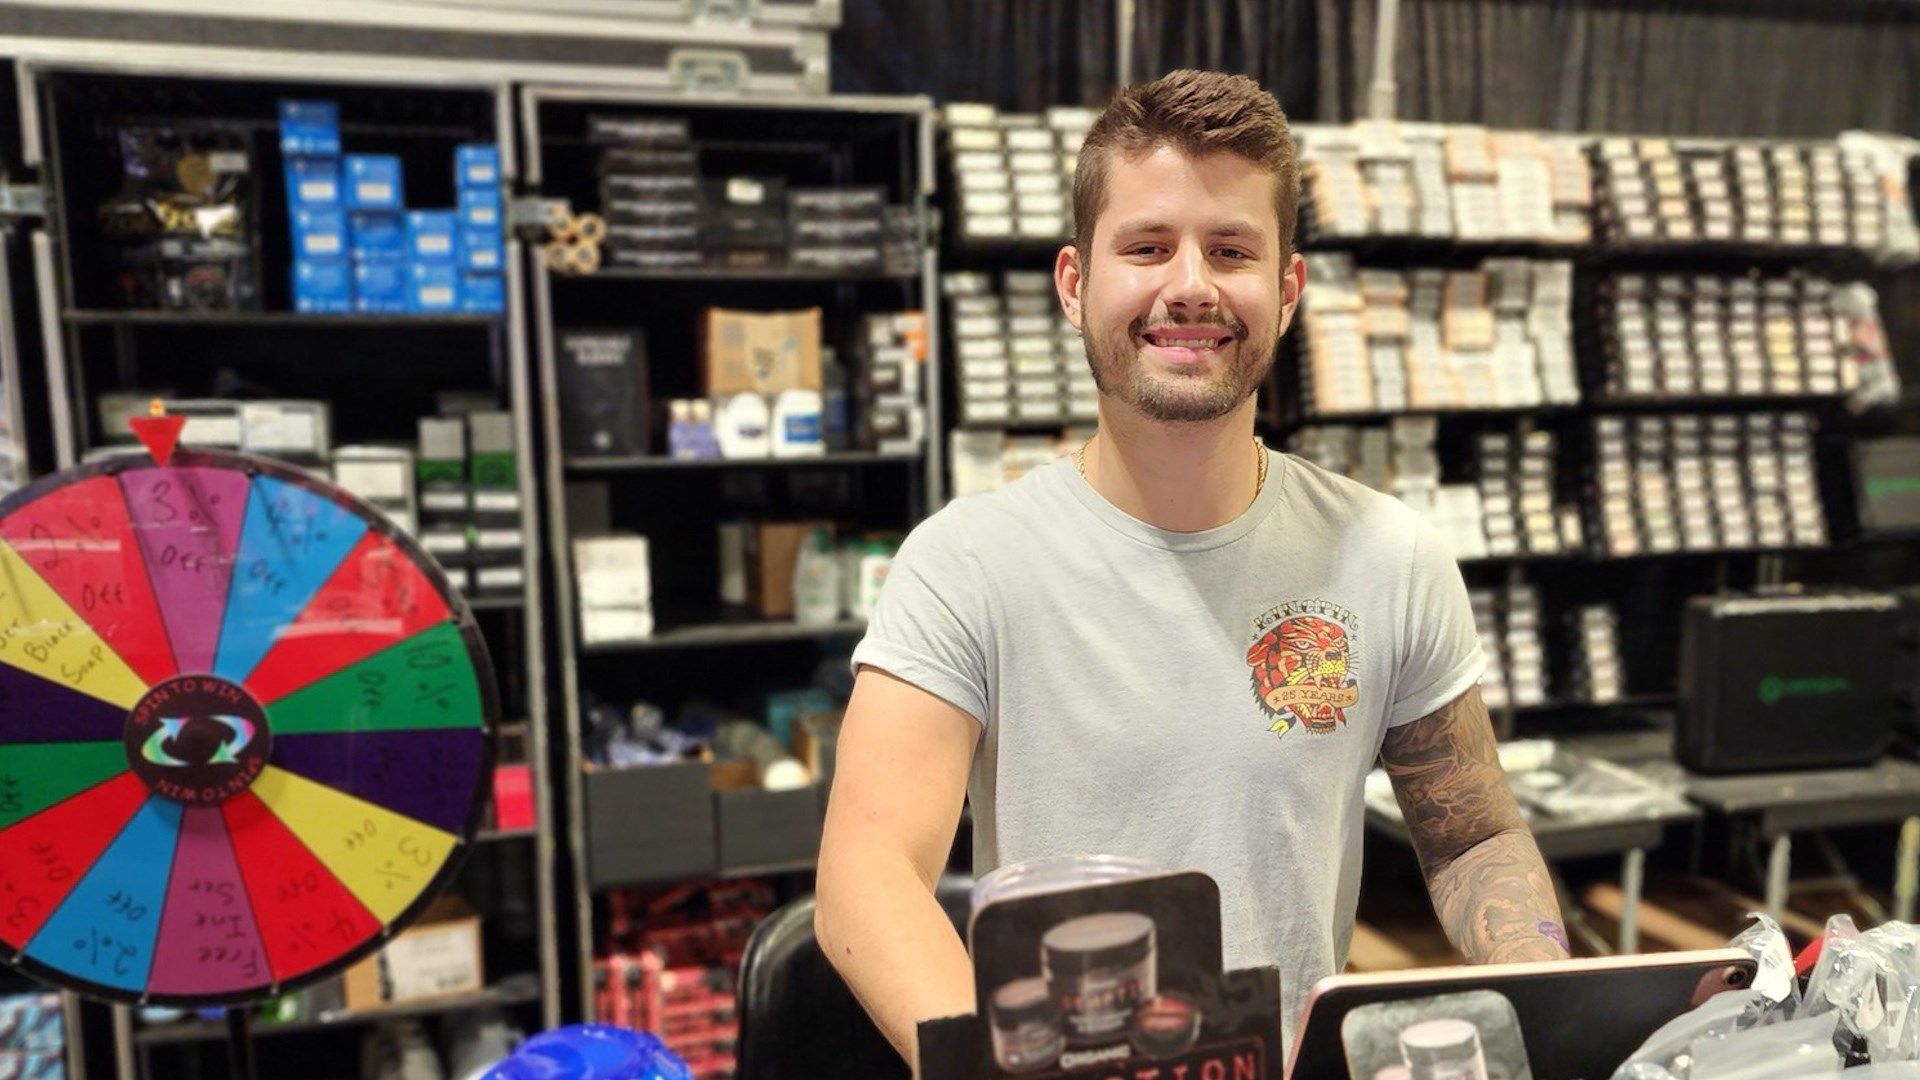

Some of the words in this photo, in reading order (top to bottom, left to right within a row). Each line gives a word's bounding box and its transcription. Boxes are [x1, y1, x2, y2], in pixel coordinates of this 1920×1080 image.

[153, 480, 221, 523] 3%
[30, 514, 102, 570] 2%
[82, 582, 123, 612] Off
[1253, 597, 1359, 630] KINGPIN
[405, 640, 458, 708] 10%
[135, 686, 169, 724] SPIN
[169, 679, 197, 694] TO
[202, 679, 242, 704] WIN
[1281, 690, 1297, 701] 25
[1301, 690, 1345, 702] YEARS
[155, 779, 197, 801] WIN
[226, 755, 262, 791] SPIN
[202, 786, 228, 801] TO
[375, 835, 432, 890] 3%
[73, 926, 137, 976] 2%
[199, 946, 258, 979] Free
